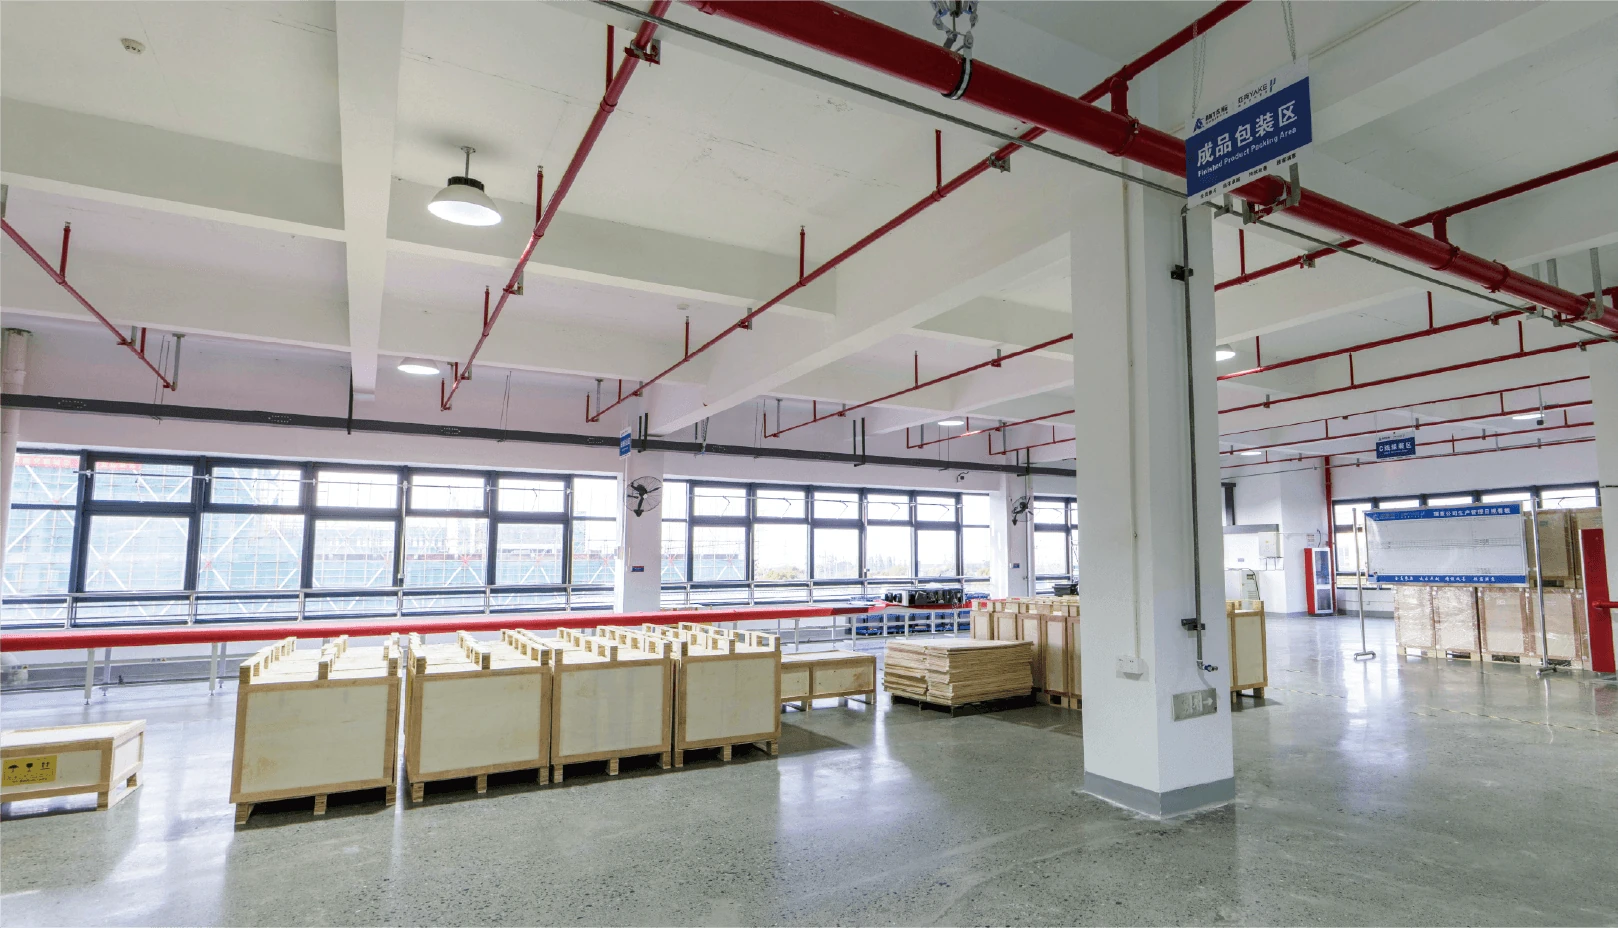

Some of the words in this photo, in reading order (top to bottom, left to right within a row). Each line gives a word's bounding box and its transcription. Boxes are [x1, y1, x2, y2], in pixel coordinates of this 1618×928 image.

[1197, 100, 1298, 167] 成品包装区
[1197, 160, 1223, 178] Finished
[1223, 148, 1250, 166] Product
[1250, 136, 1279, 153] Packing
[1279, 127, 1297, 139] Area
